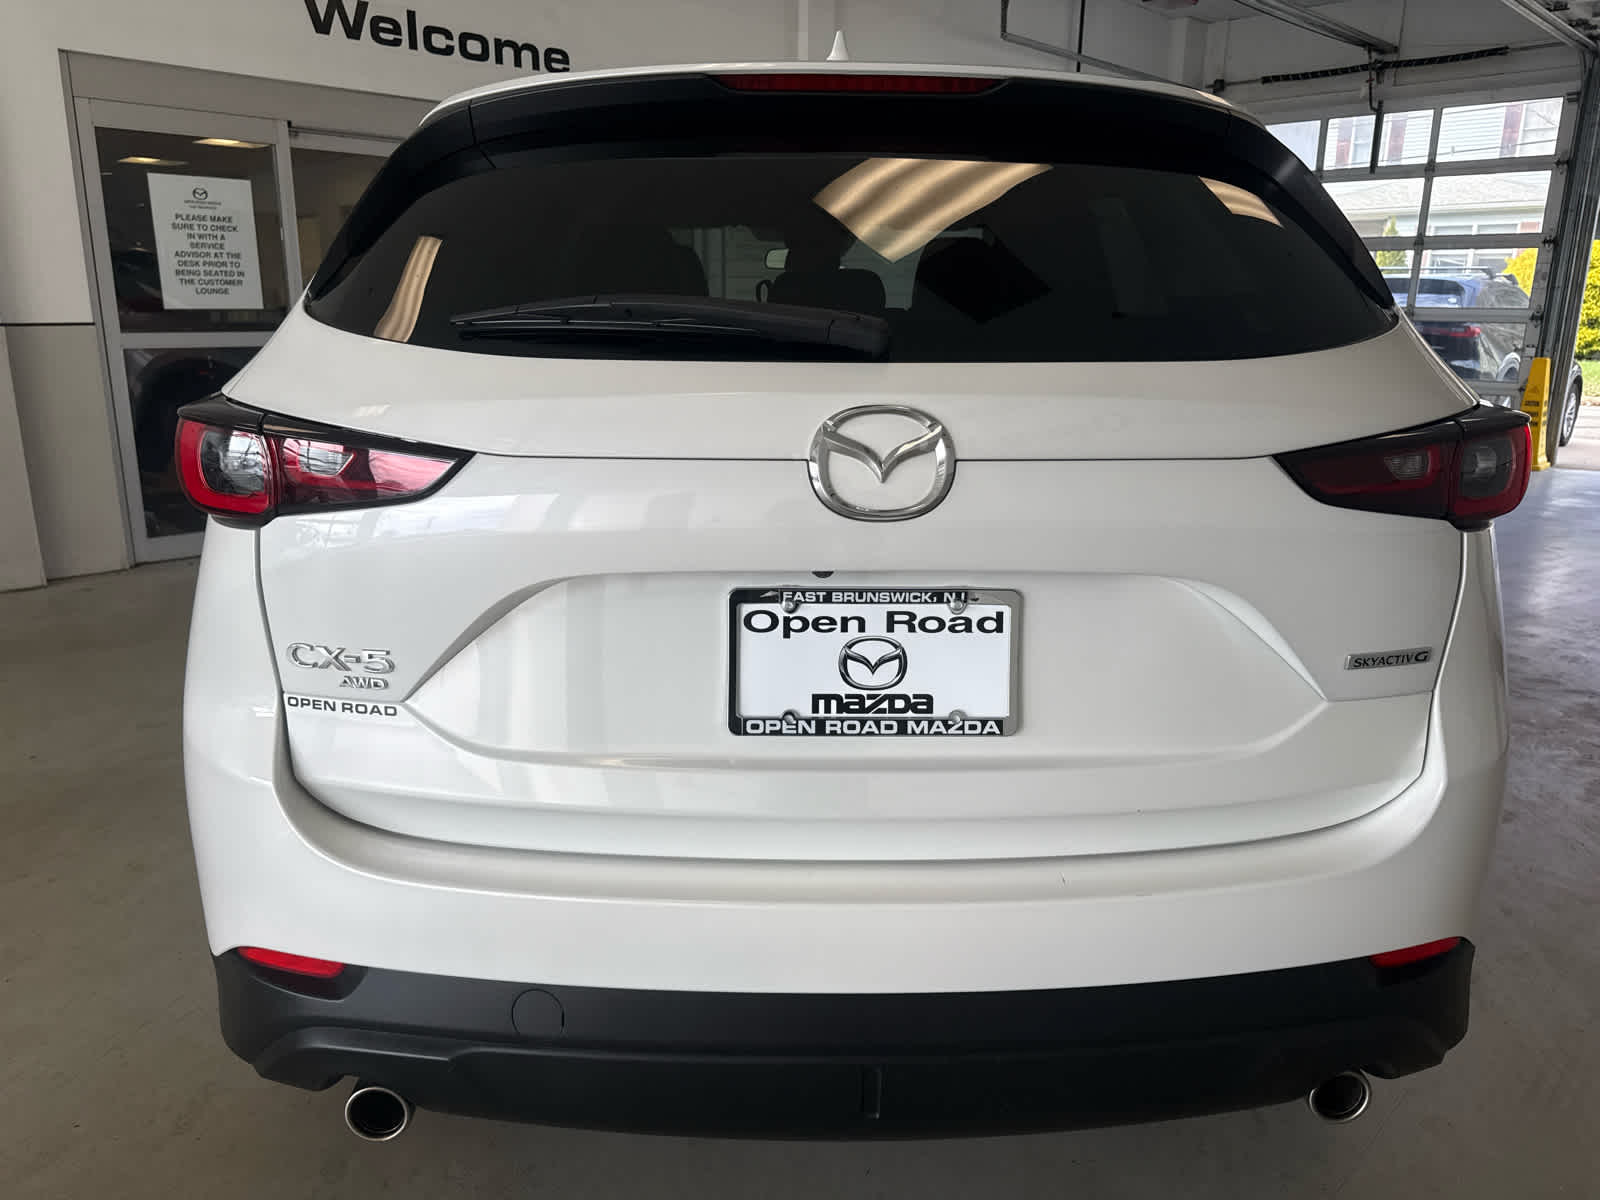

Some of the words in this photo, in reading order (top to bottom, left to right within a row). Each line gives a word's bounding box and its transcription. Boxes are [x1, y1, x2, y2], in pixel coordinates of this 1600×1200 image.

[305, 0, 571, 73] Welcome
[175, 213, 208, 221] PLEASE
[209, 215, 233, 223] MAKE
[171, 222, 195, 230] SURE
[197, 223, 208, 231] TO
[210, 224, 239, 232] CHECK
[187, 232, 195, 240] IN
[197, 233, 218, 241] WITH
[190, 241, 225, 250] SERVICE
[175, 250, 211, 259] ADVISOR
[175, 269, 200, 277] BEING
[202, 270, 235, 278] SEATED
[179, 278, 196, 286] THE
[198, 279, 243, 287] CUSTOMER
[195, 287, 230, 295] LOUNGE
[743, 609, 866, 639] Open
[886, 610, 1004, 634] Road
[286, 641, 395, 674] CX-5
[339, 675, 389, 690] AWD
[287, 696, 336, 711] OPEN
[341, 702, 397, 717] ROAD
[745, 719, 816, 734] OPEN
[825, 720, 898, 734] ROAD
[907, 720, 1001, 734] MAZDA
